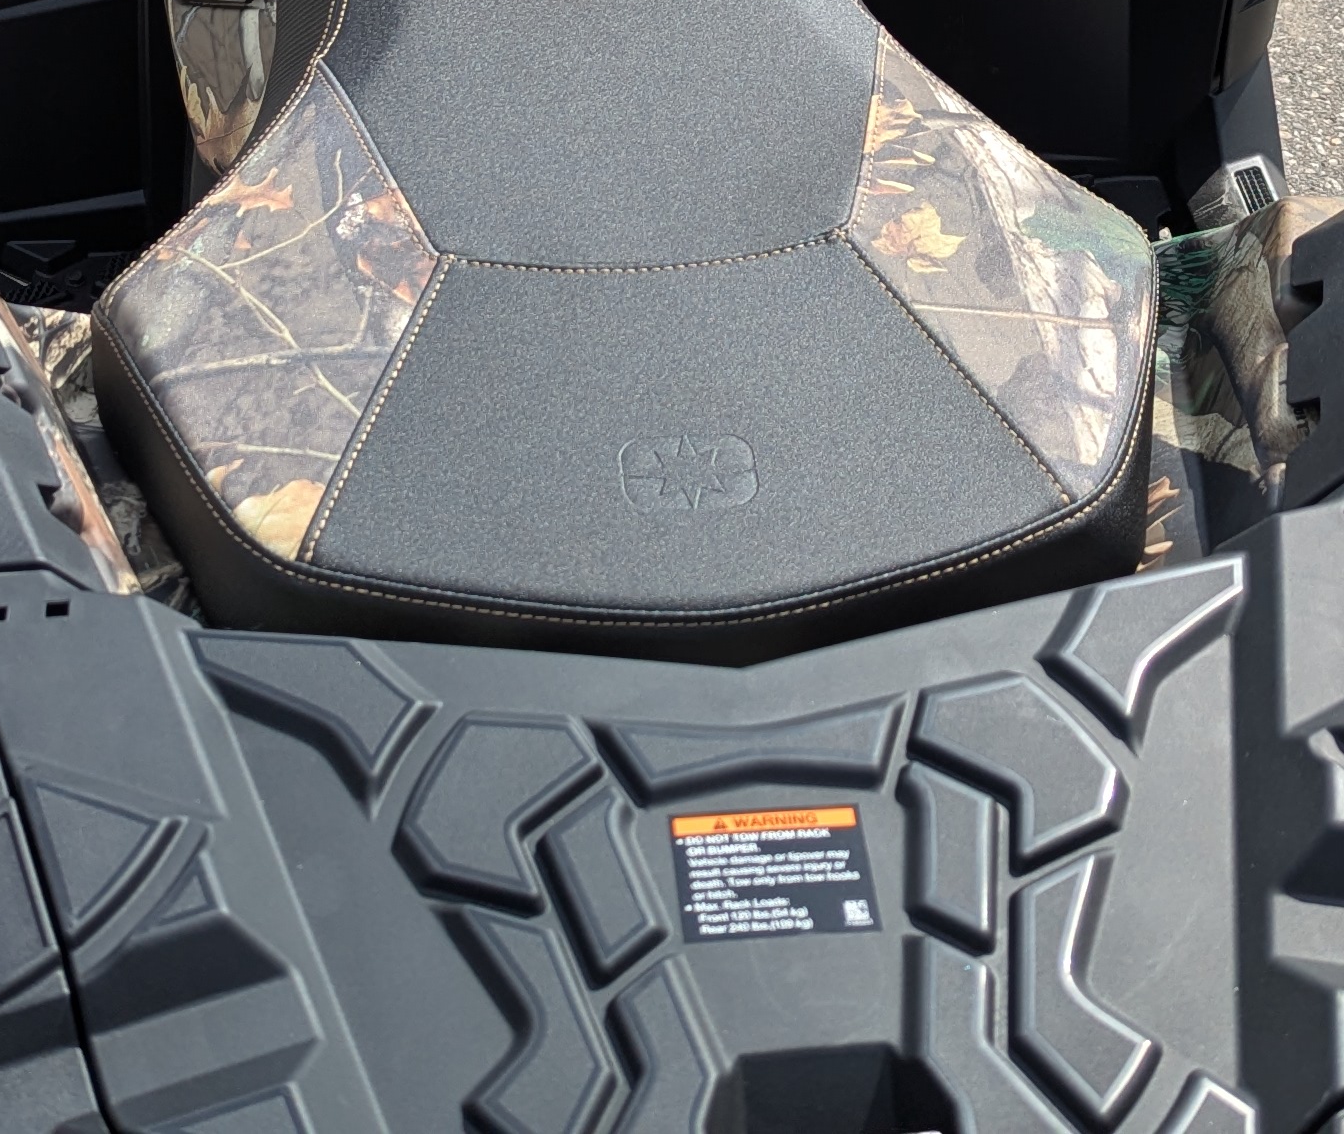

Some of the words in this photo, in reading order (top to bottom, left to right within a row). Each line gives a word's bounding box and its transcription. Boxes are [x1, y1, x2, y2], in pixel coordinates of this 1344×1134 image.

[732, 812, 818, 828] WARNING
[684, 836, 703, 846] DO
[704, 834, 729, 845] NOT
[731, 832, 759, 843] TOW
[758, 830, 796, 841] FROM
[795, 828, 831, 839] RACK
